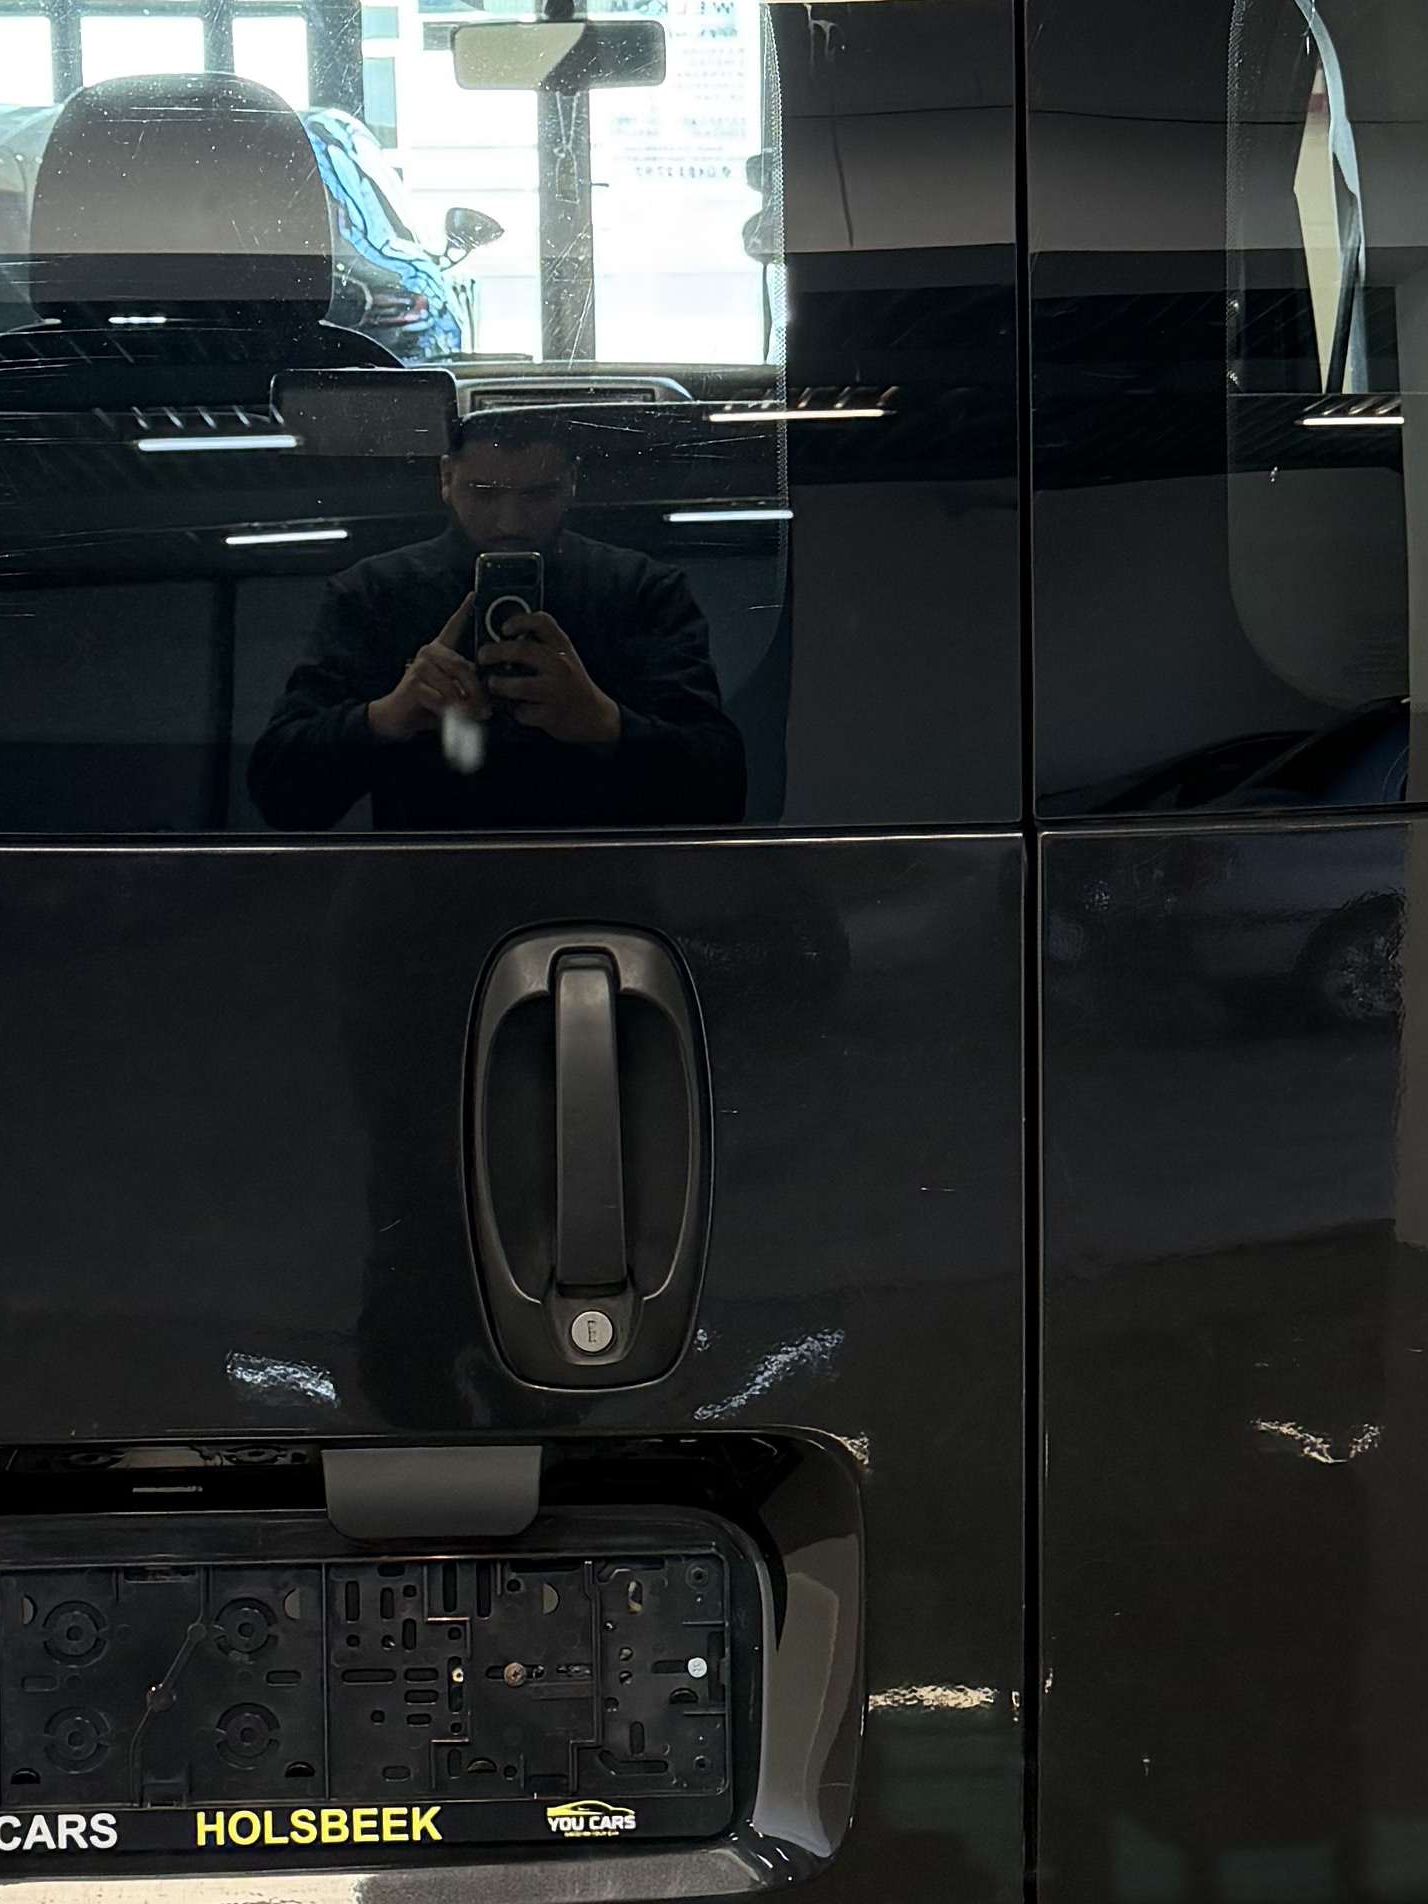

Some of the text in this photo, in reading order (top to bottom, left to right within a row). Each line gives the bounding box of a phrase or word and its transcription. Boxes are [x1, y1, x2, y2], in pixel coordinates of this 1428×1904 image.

[195, 1805, 443, 1847] HOLSBEEK
[547, 1815, 637, 1832] YOU CARS
